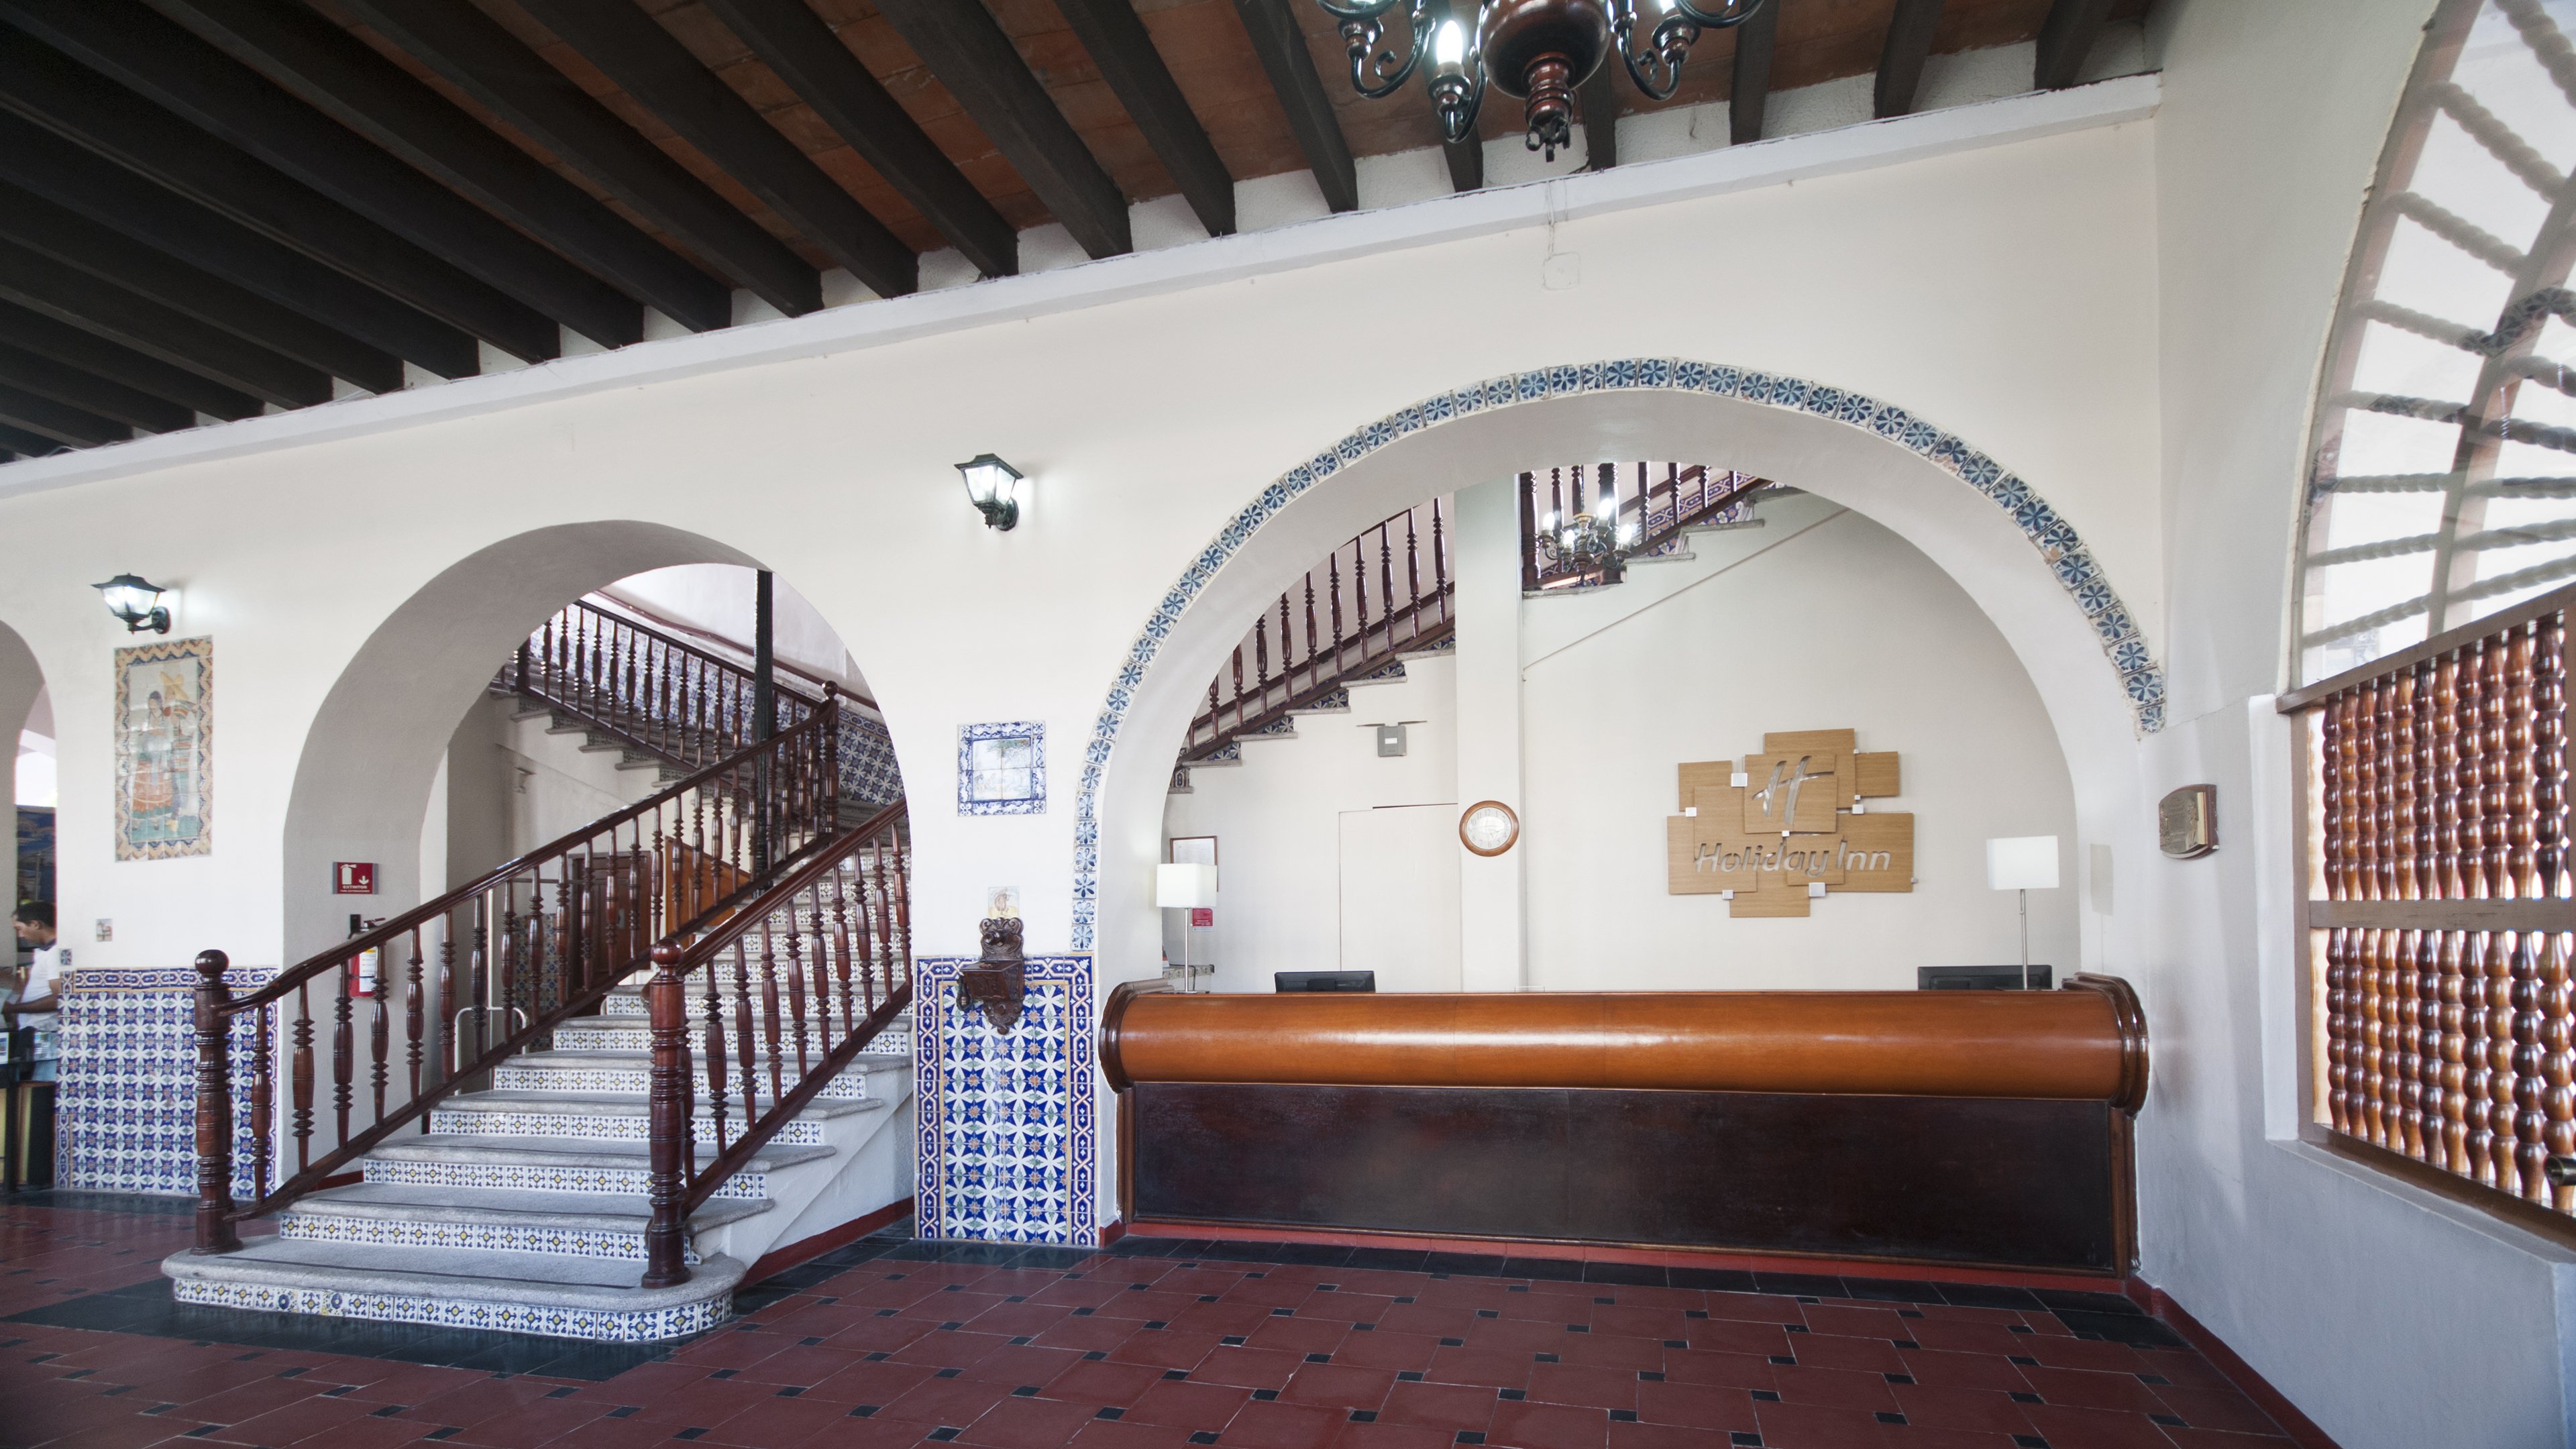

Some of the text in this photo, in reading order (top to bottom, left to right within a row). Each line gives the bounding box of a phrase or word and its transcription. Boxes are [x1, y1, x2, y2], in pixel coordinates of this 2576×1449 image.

[1752, 755, 1835, 824] H
[1695, 839, 1891, 878] Holiday Inn
